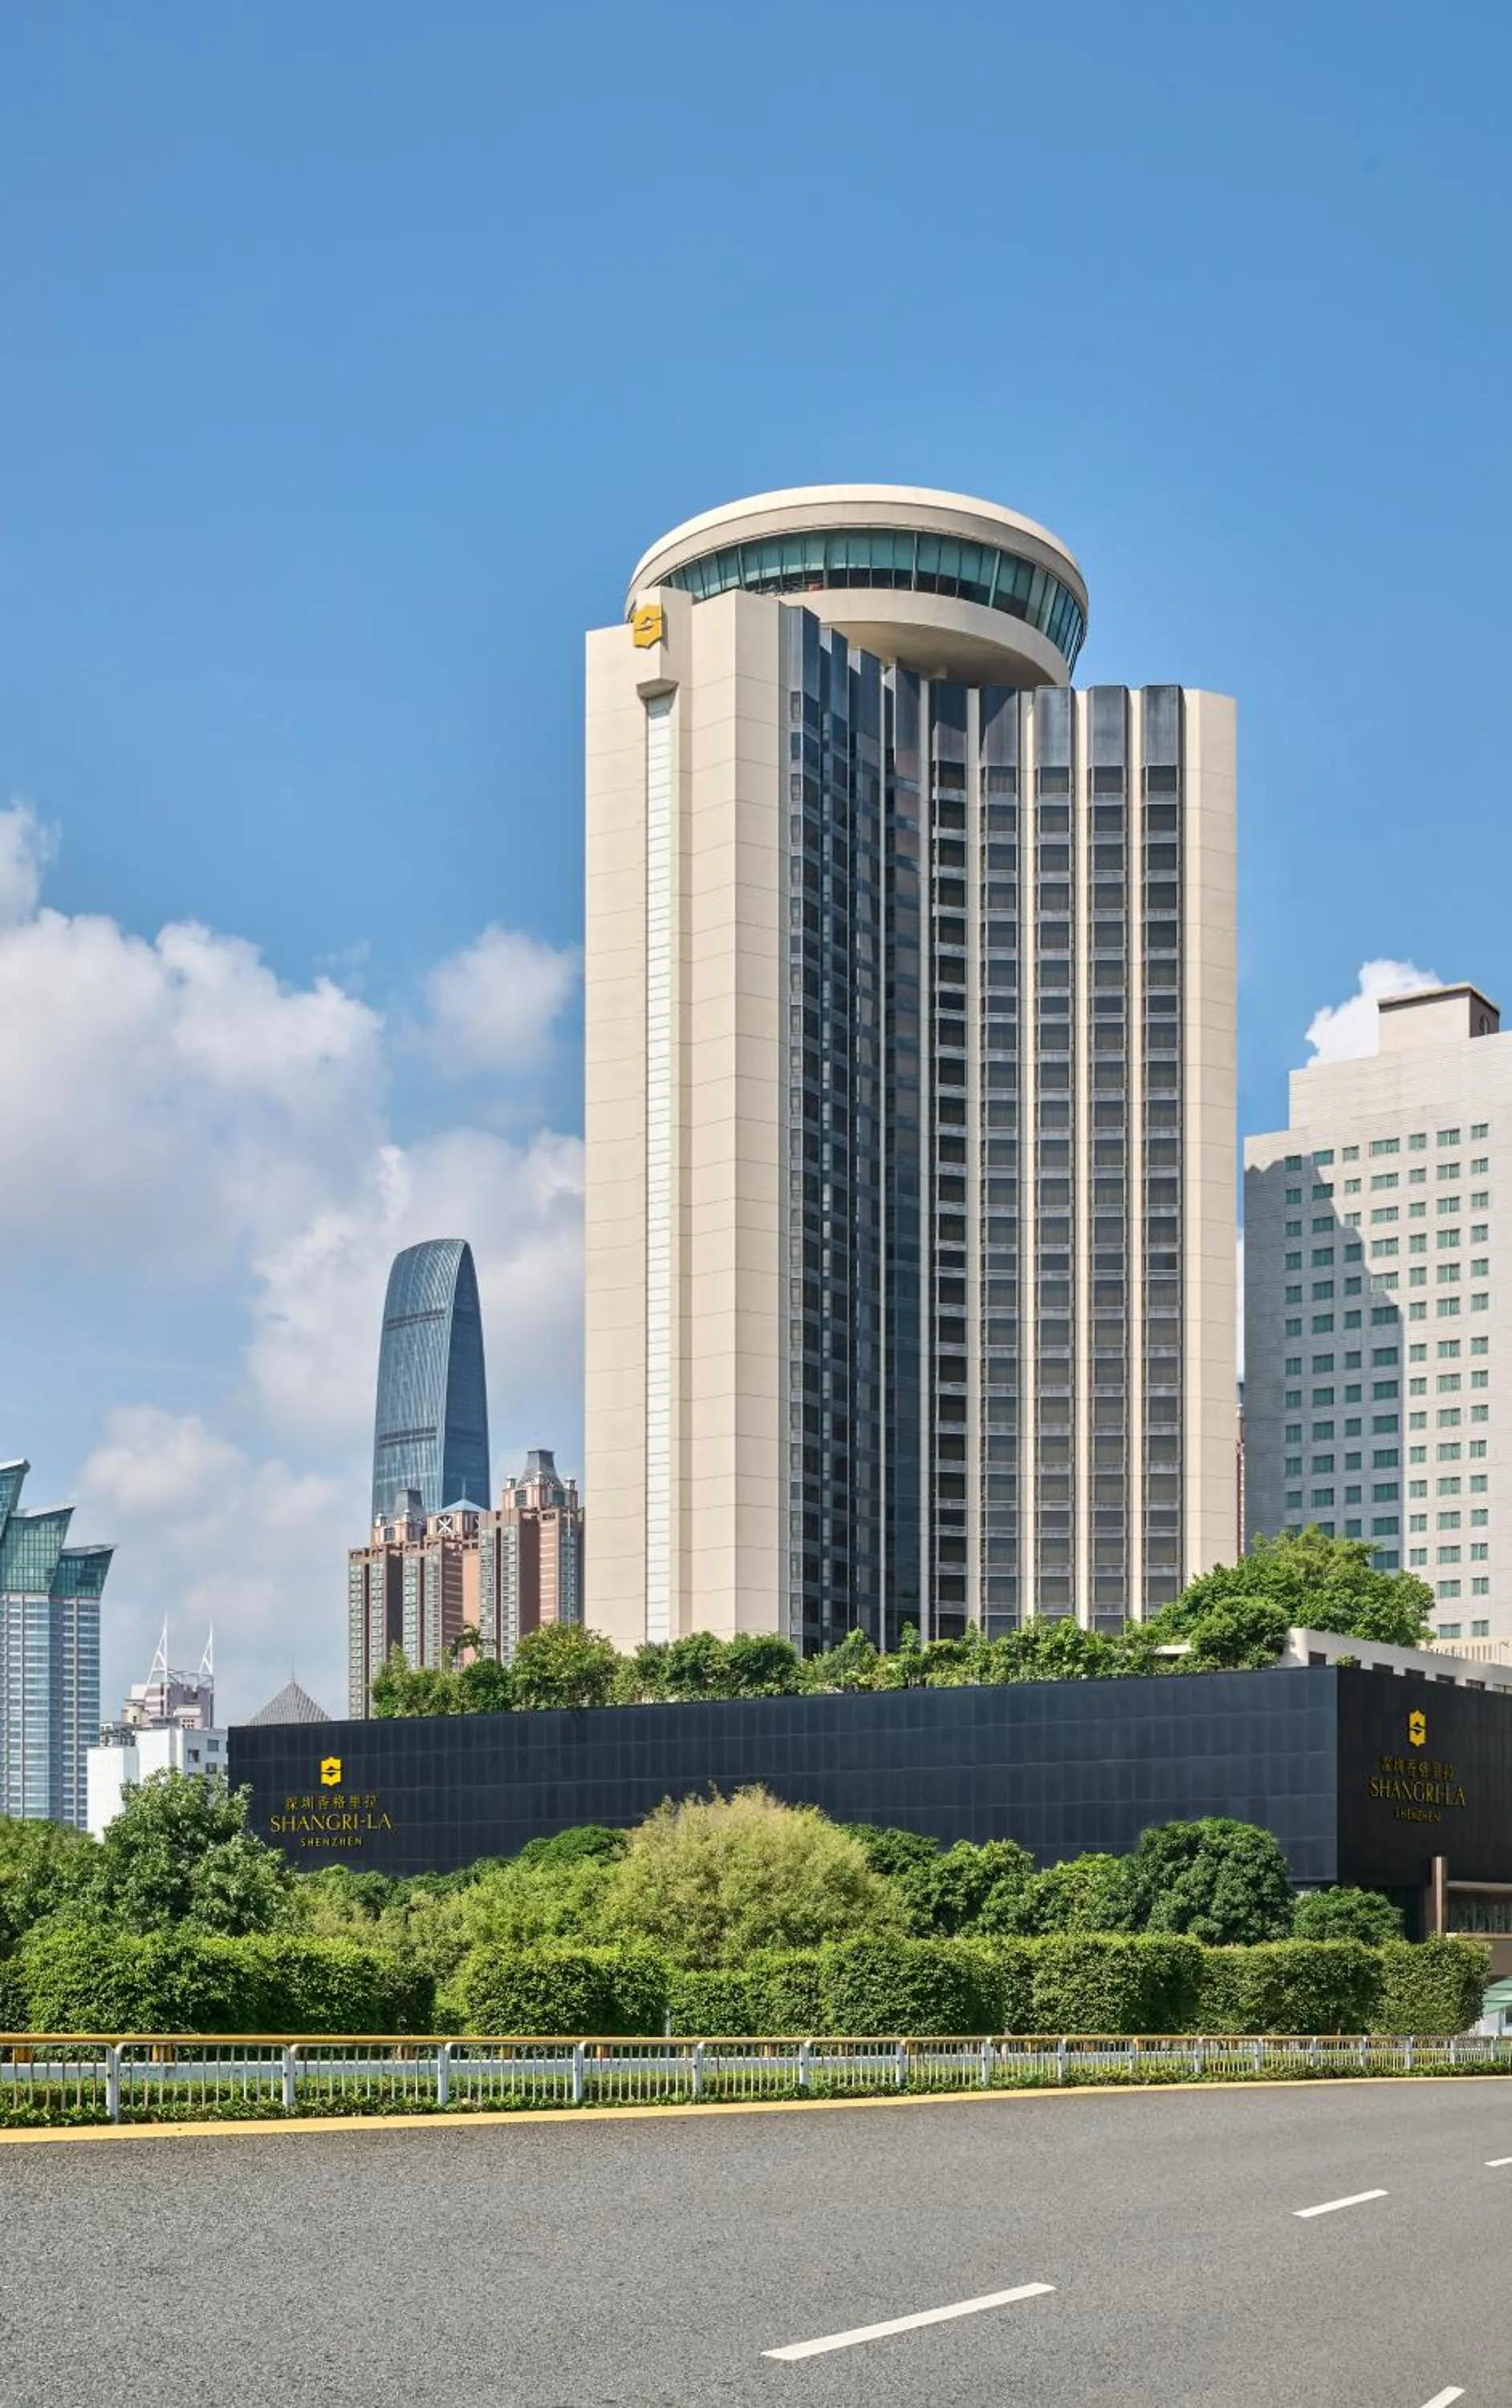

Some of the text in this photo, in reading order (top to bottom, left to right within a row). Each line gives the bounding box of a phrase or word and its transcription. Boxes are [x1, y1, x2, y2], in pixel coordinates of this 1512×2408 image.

[1369, 1777, 1466, 1807] SHANGRI-LA
[270, 1812, 392, 1832] SHANGRI-LA
[301, 1837, 362, 1847] SHENZHEN
